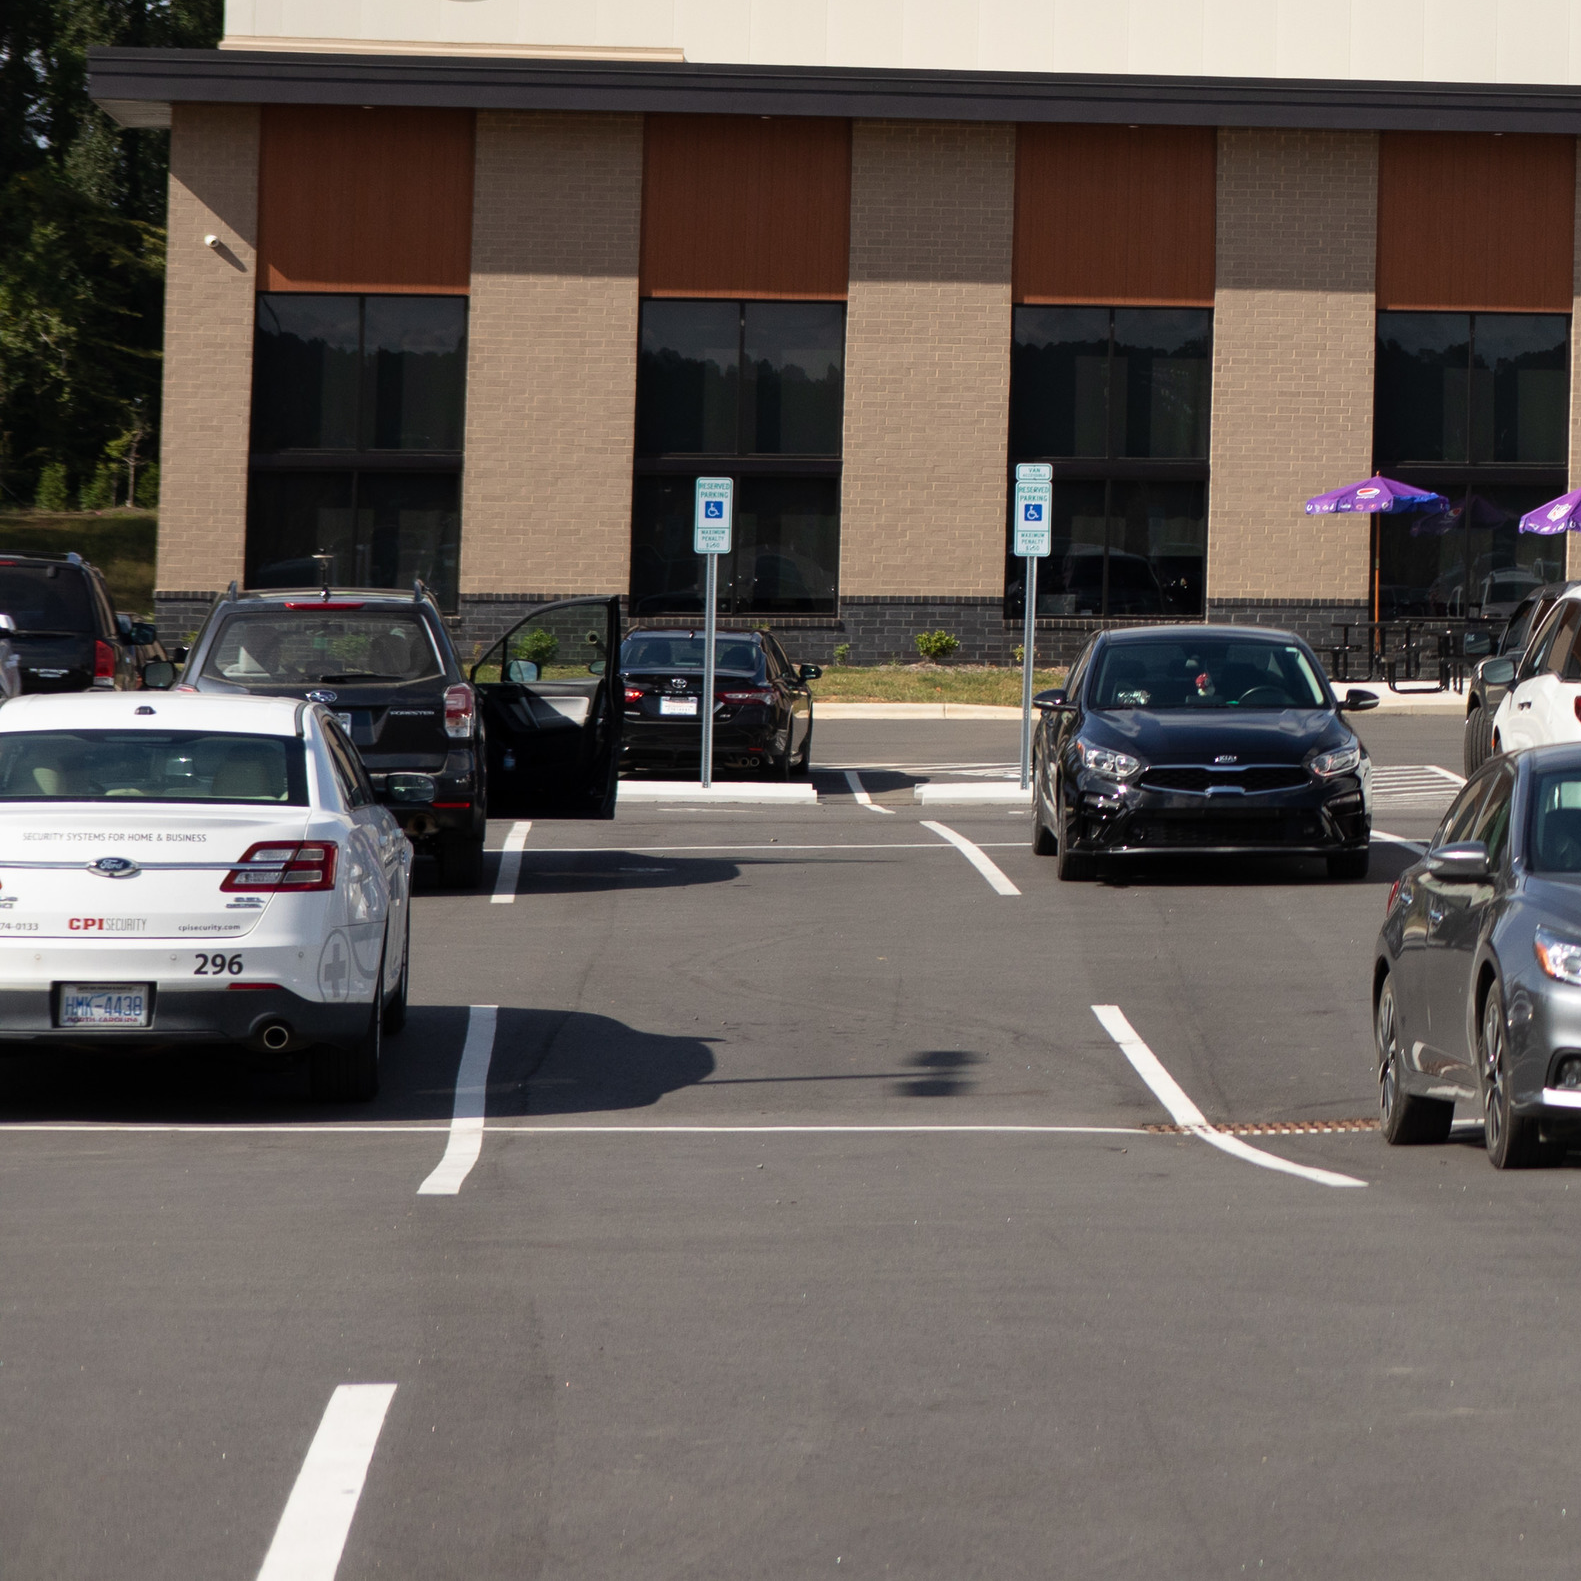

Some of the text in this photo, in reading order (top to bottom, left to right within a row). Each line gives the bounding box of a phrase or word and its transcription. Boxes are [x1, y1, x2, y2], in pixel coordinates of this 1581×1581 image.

[698, 482, 731, 490] RESERVED
[1018, 486, 1050, 494] RESERVED
[700, 491, 729, 499] PARKING
[1019, 494, 1048, 502] PARKING
[23, 832, 207, 843] SECURITY SYSTEMS FOR HOME & BUSINESS
[99, 859, 125, 870] Ford
[68, 917, 148, 932] CPI SECURITY
[178, 922, 241, 933] cpisecurity.com
[193, 952, 244, 976] 296
[65, 996, 143, 1017] HMK-4438
